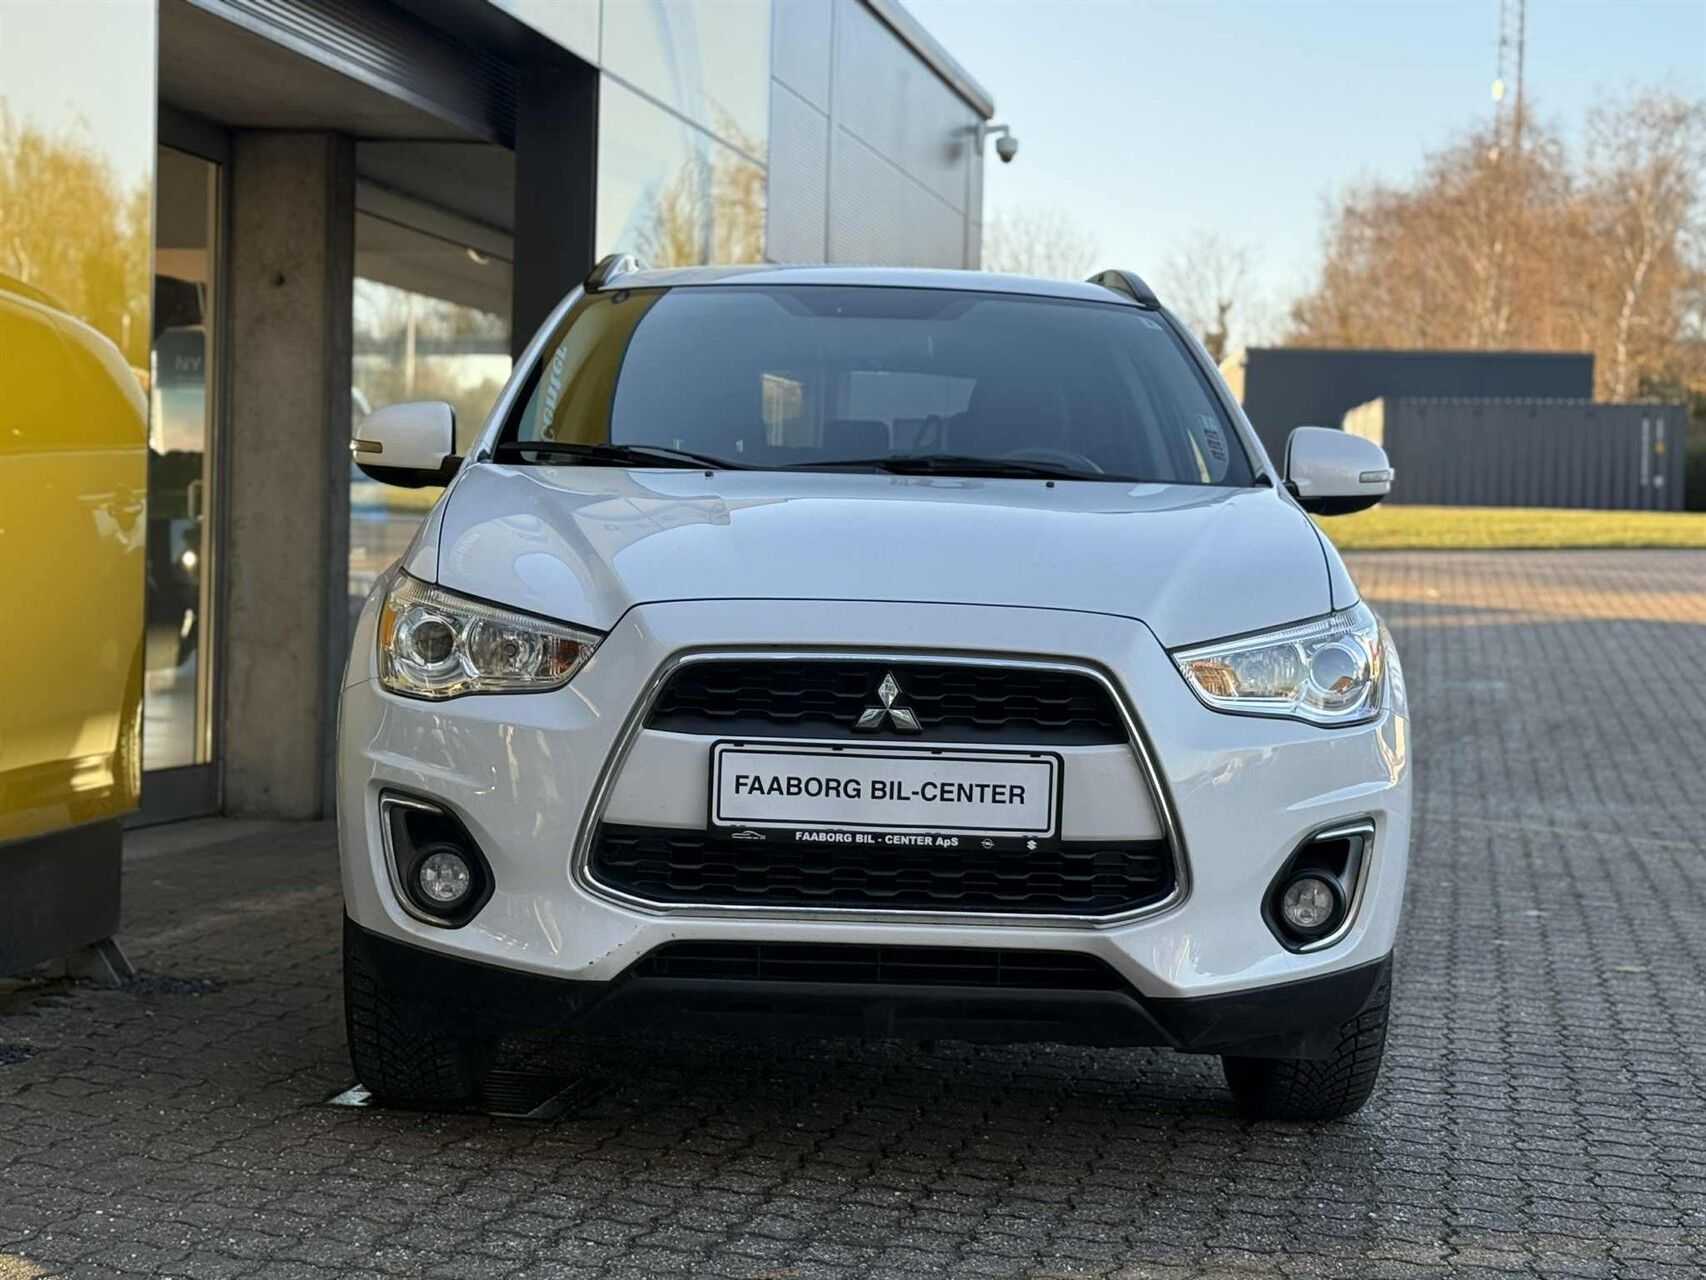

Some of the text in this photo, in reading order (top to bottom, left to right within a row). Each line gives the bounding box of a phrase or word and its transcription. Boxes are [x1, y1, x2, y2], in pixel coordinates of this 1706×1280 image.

[734, 774, 1026, 804] FAABORG BIL-CENTER
[795, 831, 852, 844] FAABORG
[855, 833, 876, 844] BIL
[885, 834, 933, 846] CENTER
[935, 836, 959, 848] ApS
